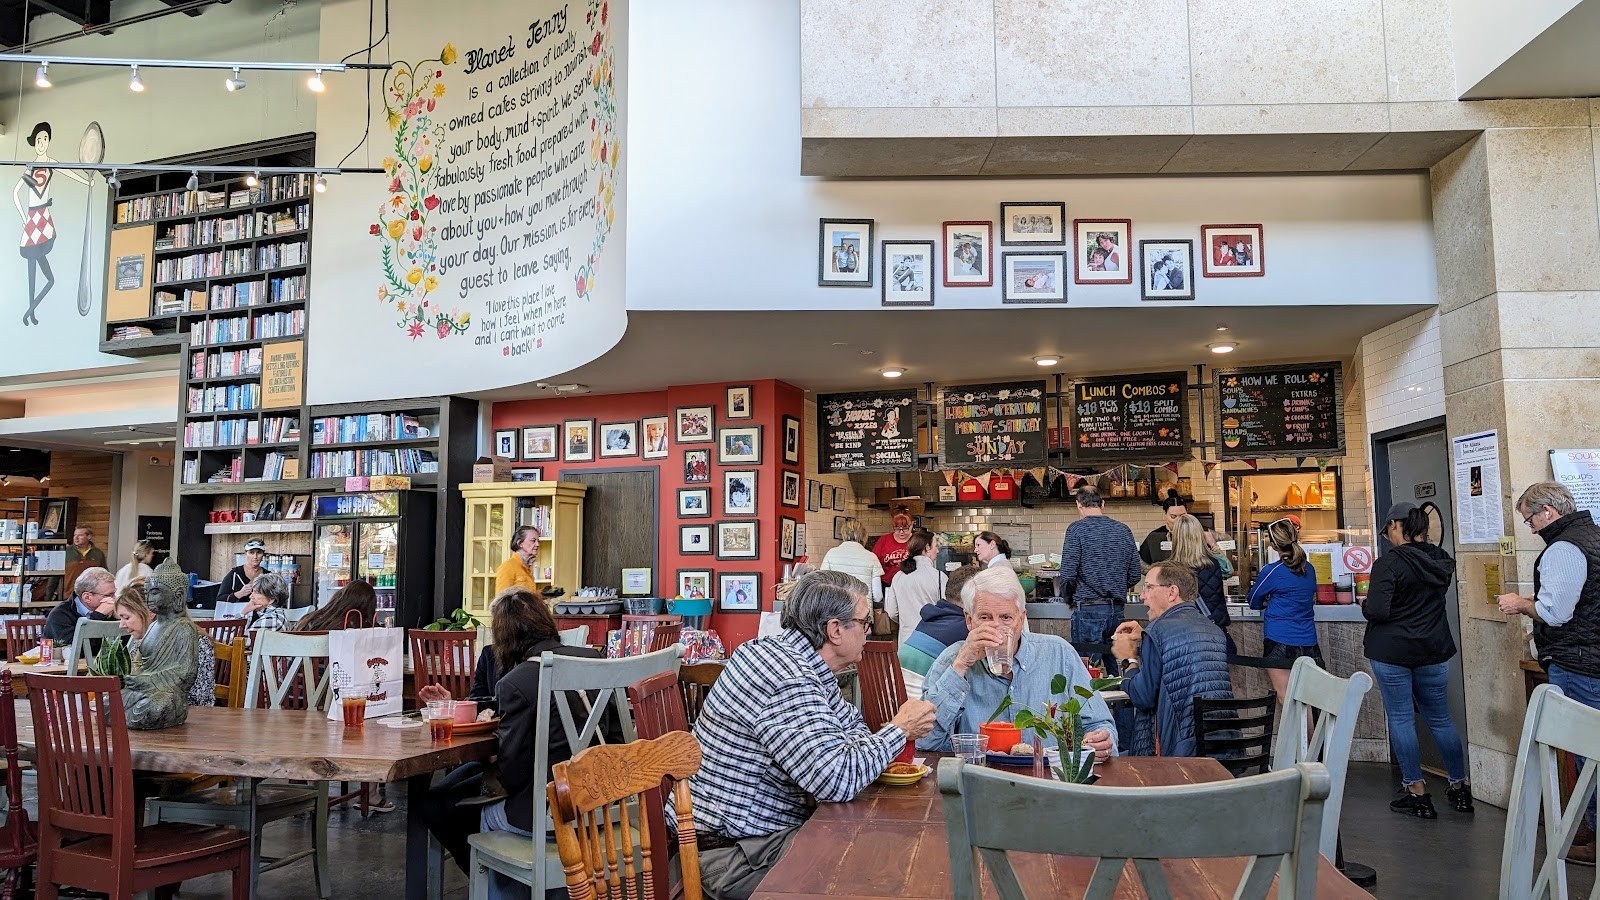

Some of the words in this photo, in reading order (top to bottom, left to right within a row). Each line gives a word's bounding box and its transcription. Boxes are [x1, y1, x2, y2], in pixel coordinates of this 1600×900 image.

[463, 35, 516, 74] Planet
[526, 3, 568, 49] Jenny
[486, 81, 493, 93] a
[498, 60, 540, 89] collection
[542, 48, 551, 68] of
[553, 30, 577, 61] locally
[448, 101, 485, 131] owned
[488, 95, 517, 119] cafes
[520, 76, 552, 107] striving
[554, 70, 563, 86] to
[563, 41, 588, 81] nourish
[447, 139, 474, 164] your
[505, 111, 529, 142] mind
[561, 90, 573, 110] We
[573, 70, 592, 100] serve
[433, 160, 485, 190] fabulously
[488, 148, 514, 173] fresh
[515, 135, 537, 166] food
[540, 112, 574, 164] prepared
[574, 102, 589, 129] with
[439, 195, 456, 215] love
[457, 189, 471, 214] by
[474, 175, 523, 213] passionate
[526, 161, 553, 197] people
[554, 149, 568, 174] who
[569, 141, 586, 164] care
[440, 215, 474, 241] about
[476, 215, 498, 241] you
[504, 203, 525, 227] how
[525, 199, 543, 226] you
[545, 187, 561, 210] move
[562, 162, 588, 201] through
[438, 250, 470, 276] your
[472, 242, 499, 266] day.
[500, 235, 520, 256] Our
[559, 216, 567, 233] is
[567, 204, 578, 229] for
[578, 195, 596, 222] every
[459, 268, 495, 299] guest
[497, 265, 508, 285] to
[513, 260, 540, 281] leave
[492, 299, 507, 313] love
[507, 295, 520, 310] this
[521, 291, 540, 312] place
[544, 284, 555, 298] love
[481, 316, 497, 332] how
[504, 310, 520, 327] feel
[523, 306, 543, 322] when
[553, 295, 567, 311] here
[474, 331, 492, 346] and
[520, 322, 536, 338] wait
[537, 321, 545, 334] to
[546, 312, 565, 330] come
[1081, 385, 1116, 400] LUNCH
[1122, 383, 1166, 399] COMBOS
[1241, 376, 1262, 387] HOW
[1264, 375, 1278, 385] WE
[1284, 374, 1307, 384] ROLL
[1291, 390, 1318, 398] EXTRAS
[945, 404, 988, 420] HOURS
[993, 402, 1041, 416] OPERATION
[1077, 402, 1097, 416] $18
[1128, 400, 1151, 414] $18
[1153, 405, 1179, 413] COMBO
[1222, 406, 1259, 414] SANDWICHES
[845, 441, 862, 449] KIND
[875, 451, 901, 459] SOCIAL
[966, 440, 1027, 456] SUNDAY
[336, 495, 353, 513] Self
